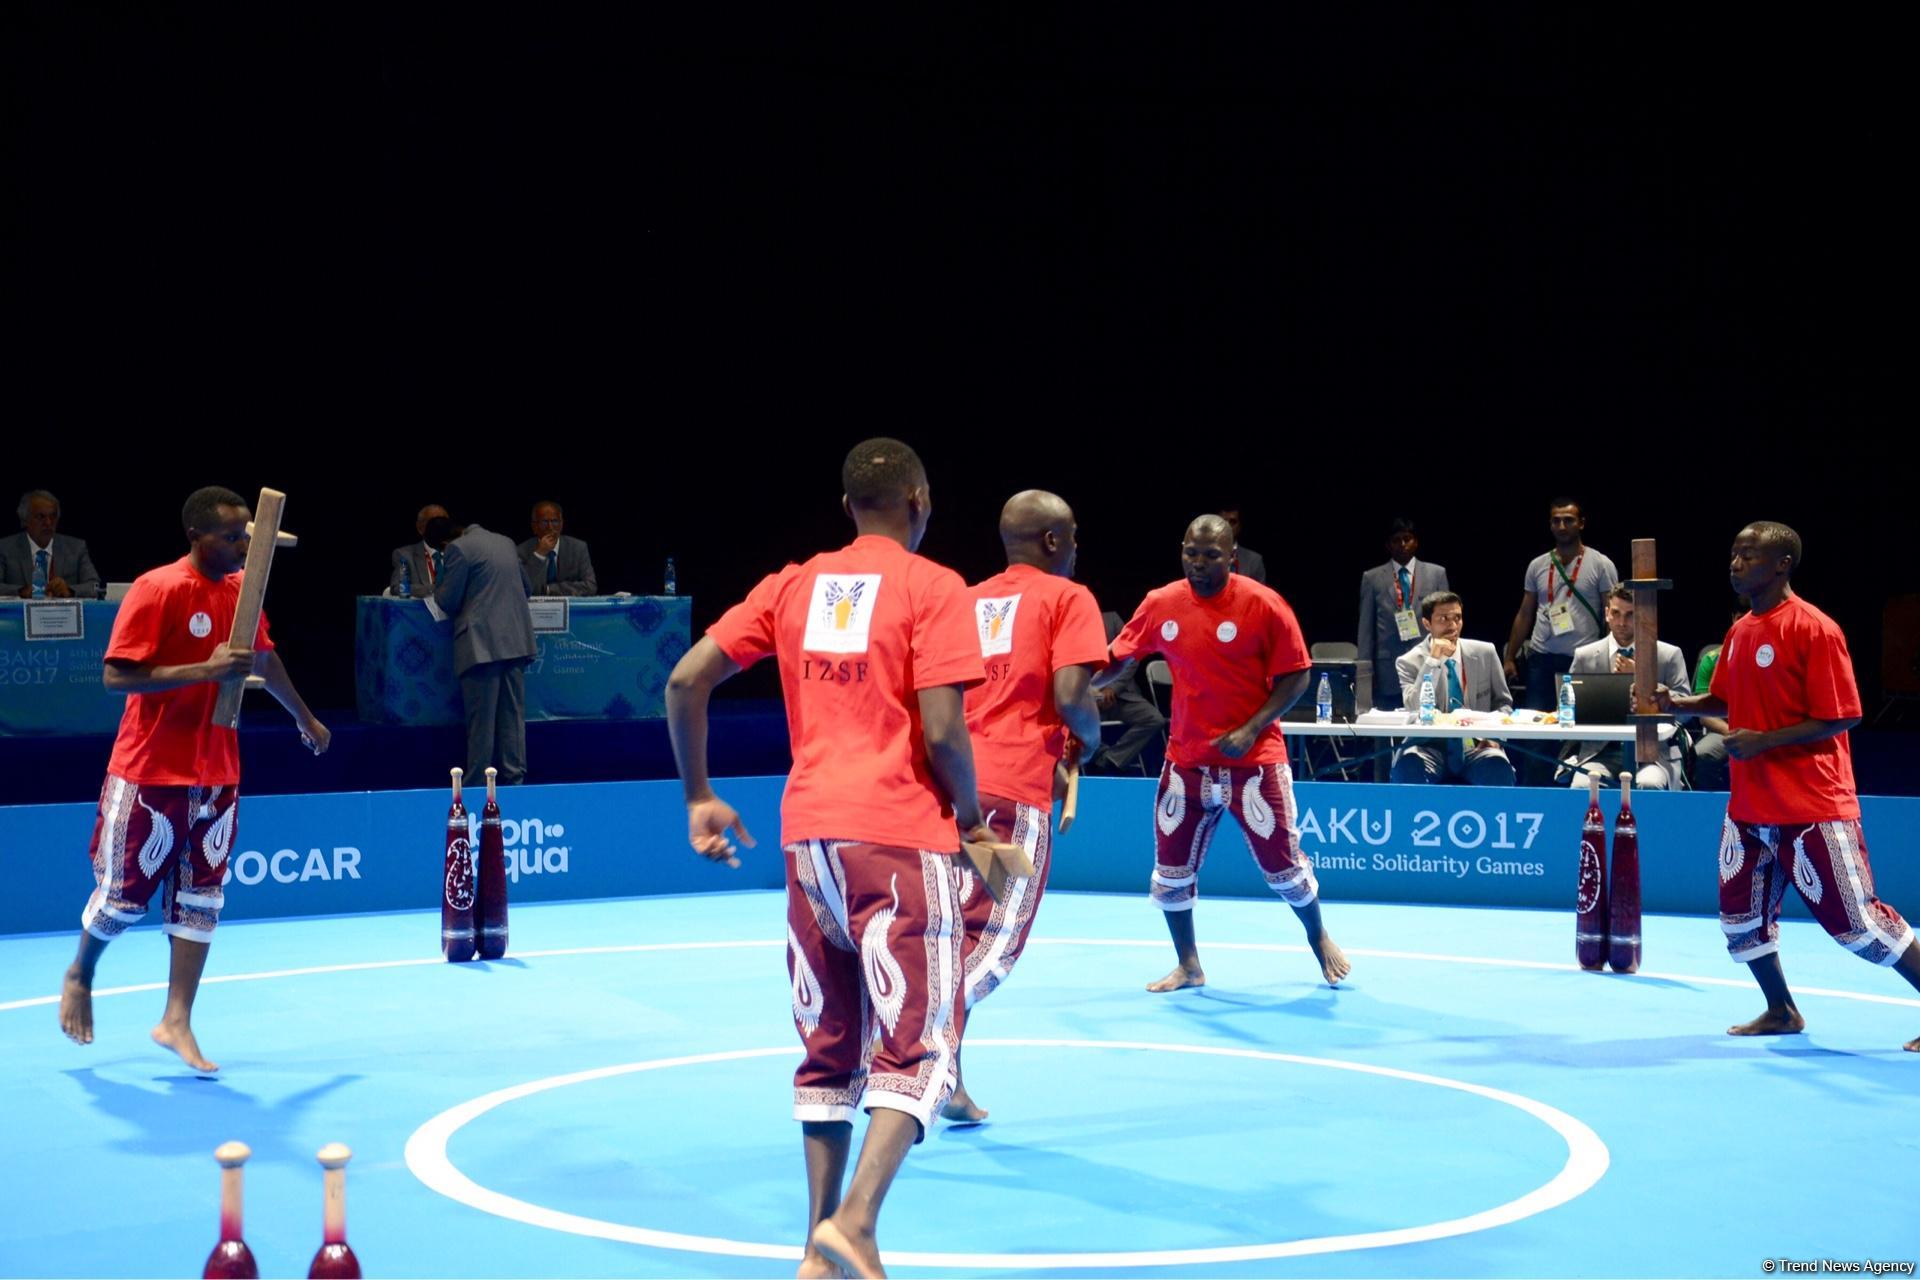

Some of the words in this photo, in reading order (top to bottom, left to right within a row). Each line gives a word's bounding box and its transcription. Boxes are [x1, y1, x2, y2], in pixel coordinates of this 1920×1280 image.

[553, 665, 585, 674] Games
[803, 659, 869, 683] IZSF
[1411, 809, 1545, 850] 2017
[1372, 854, 1470, 878] Solidarity
[1476, 856, 1544, 876] Games
